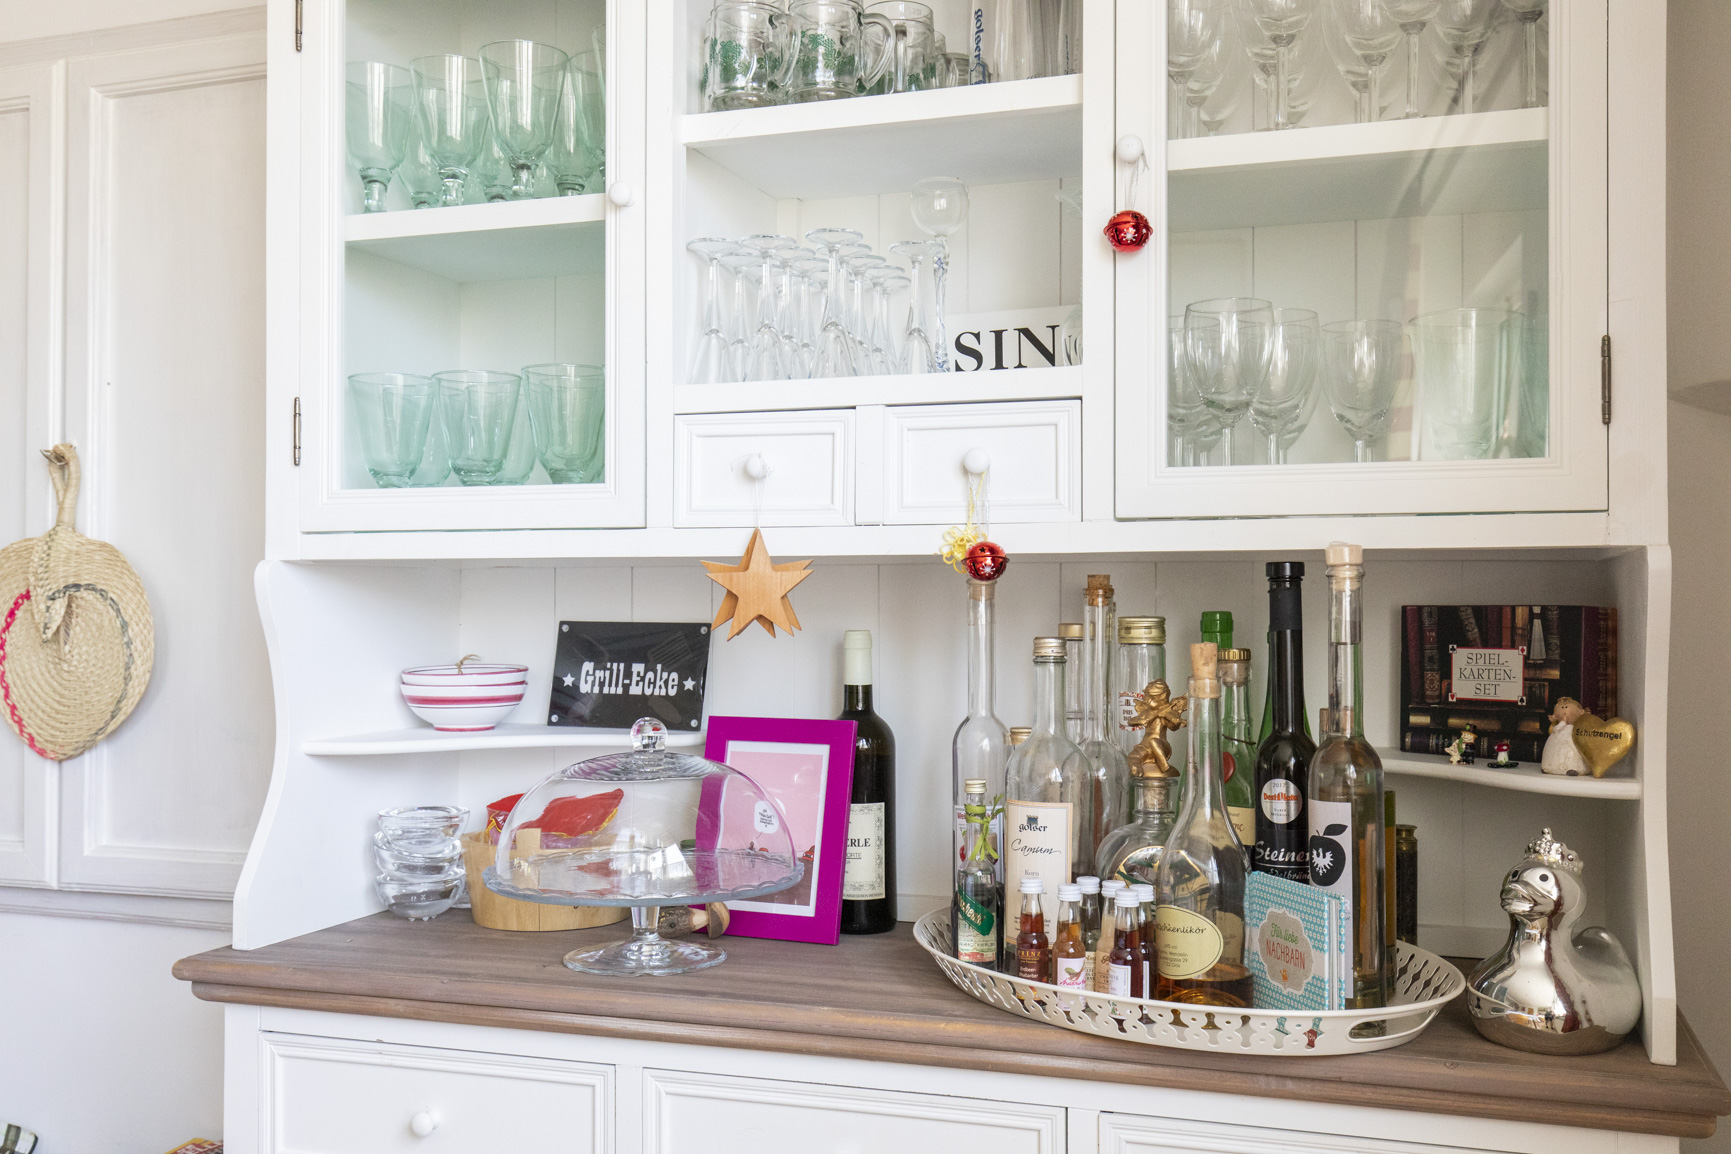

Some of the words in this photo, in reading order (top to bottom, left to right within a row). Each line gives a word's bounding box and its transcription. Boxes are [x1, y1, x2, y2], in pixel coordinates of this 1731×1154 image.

[1466, 652, 1509, 666] SPIEL-
[579, 661, 679, 698] Grill-Ecke
[1458, 667, 1517, 681] KARTEN-
[1474, 683, 1501, 696] SET
[1575, 728, 1622, 741] Schutzengel
[845, 837, 871, 847] ERLE
[1270, 922, 1283, 938] Für
[1283, 929, 1299, 945] liebe
[1265, 939, 1306, 970] NACHBARN
